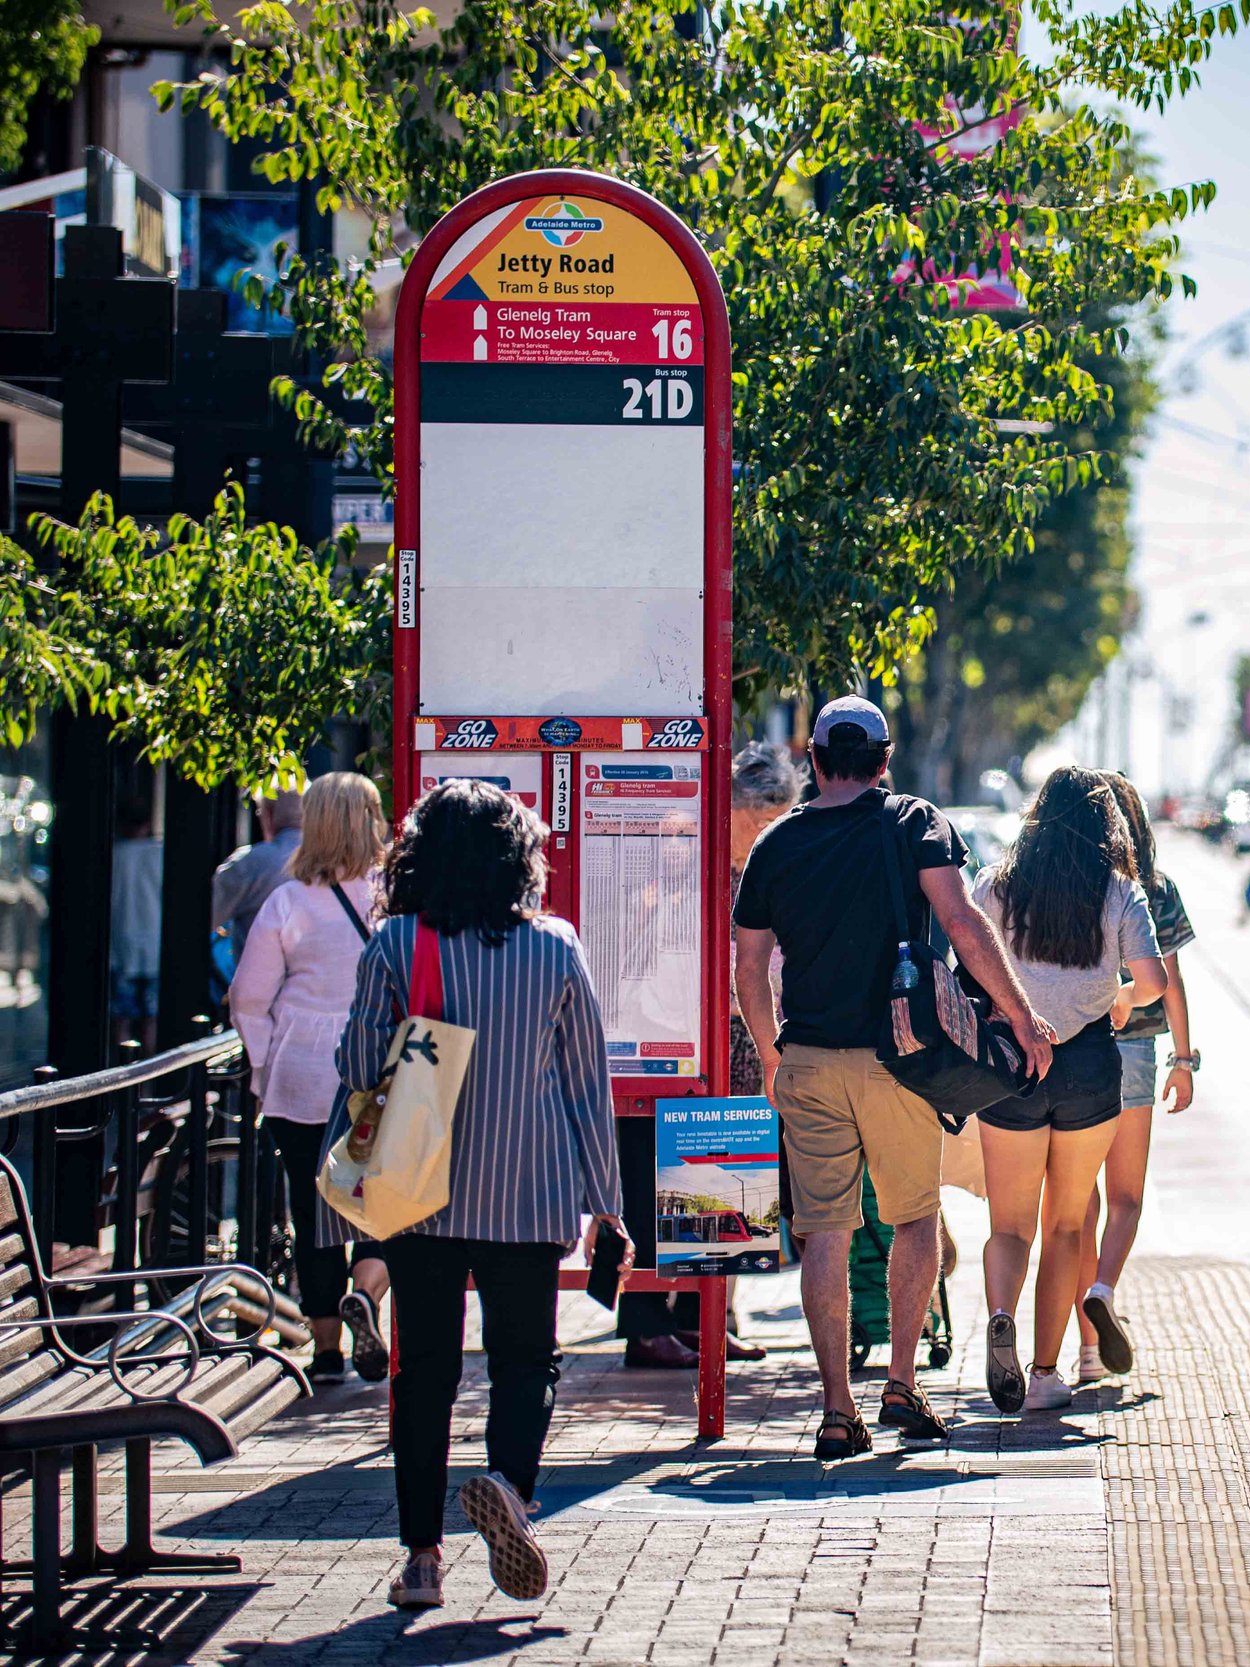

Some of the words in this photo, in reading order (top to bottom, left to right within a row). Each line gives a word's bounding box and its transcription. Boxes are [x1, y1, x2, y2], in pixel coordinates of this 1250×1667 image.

[531, 220, 569, 228] Adelaide
[570, 221, 596, 229] Metro
[497, 253, 552, 278] Jetty
[560, 253, 615, 273] Road
[498, 281, 533, 293] Tram
[538, 281, 549, 294] &
[554, 282, 579, 294] Bus
[583, 283, 615, 298] stop
[497, 308, 551, 325] Glenelg
[555, 309, 591, 322] Tram
[653, 309, 671, 317] Tram
[673, 309, 690, 318] stop
[497, 326, 515, 339] To
[520, 326, 581, 343] Moseley
[586, 327, 637, 343] Square
[652, 319, 693, 359] 16
[497, 348, 520, 356] Moseley
[550, 349, 574, 357] Brighton
[608, 356, 620, 364] City
[655, 368, 669, 376] Bus
[670, 369, 688, 378] stop
[622, 378, 694, 419] 21D
[457, 720, 487, 734] GO
[663, 719, 693, 734] GO
[441, 734, 496, 748] ZONE
[648, 734, 702, 748] ZONE
[664, 1112, 687, 1123] NEW
[690, 1110, 720, 1122] TRAM
[724, 1109, 772, 1121] SERVICES
